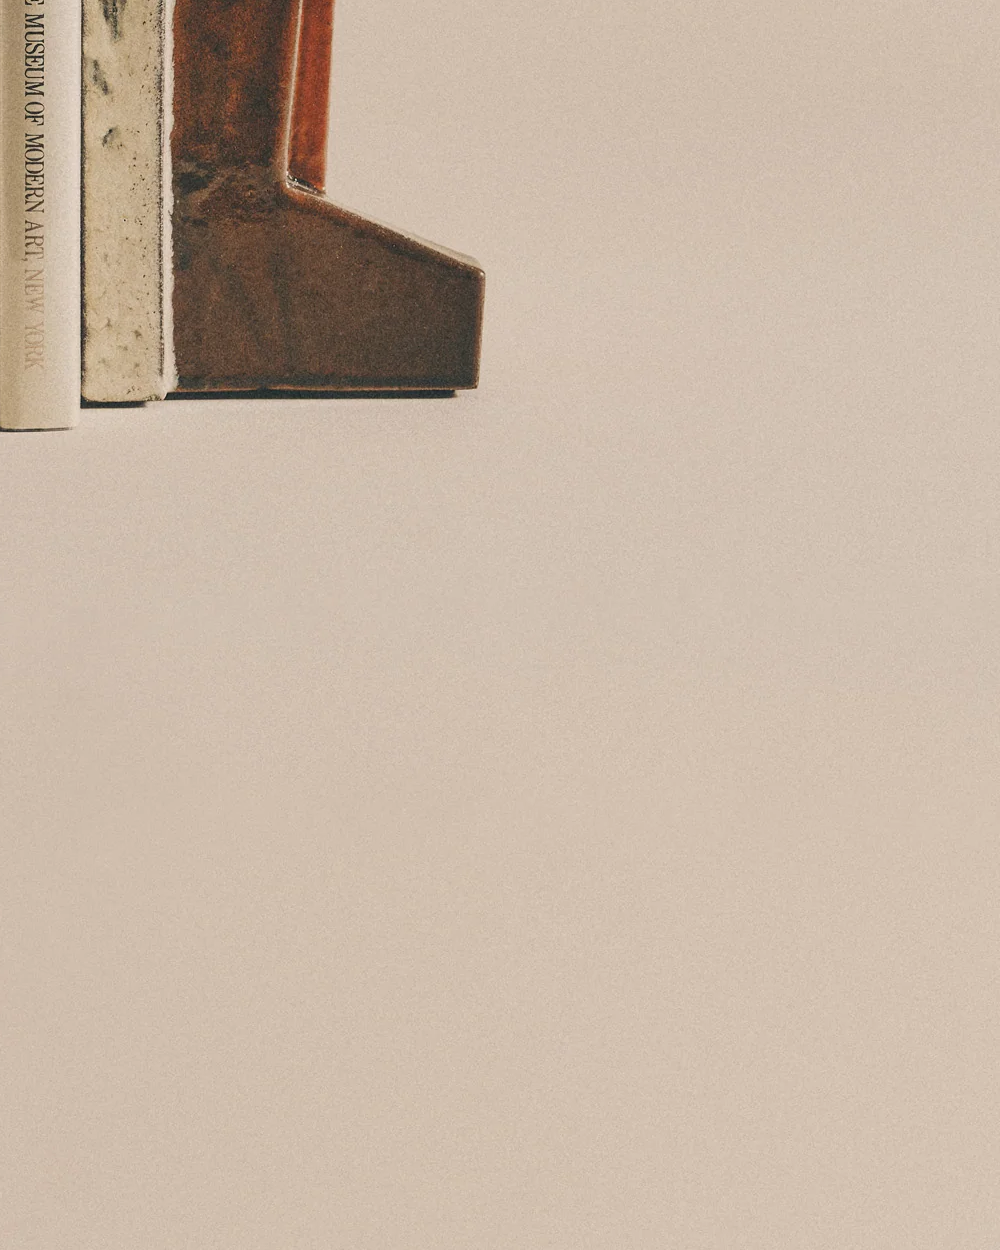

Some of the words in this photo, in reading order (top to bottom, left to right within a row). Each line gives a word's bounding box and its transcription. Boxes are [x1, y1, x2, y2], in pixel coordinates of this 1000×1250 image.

[24, 13, 45, 97] MUSEUM
[24, 101, 45, 126] OF
[24, 133, 45, 213] MODERN
[21, 219, 45, 262] ART,
[24, 268, 45, 314] NEW
[24, 319, 45, 370] YORK
